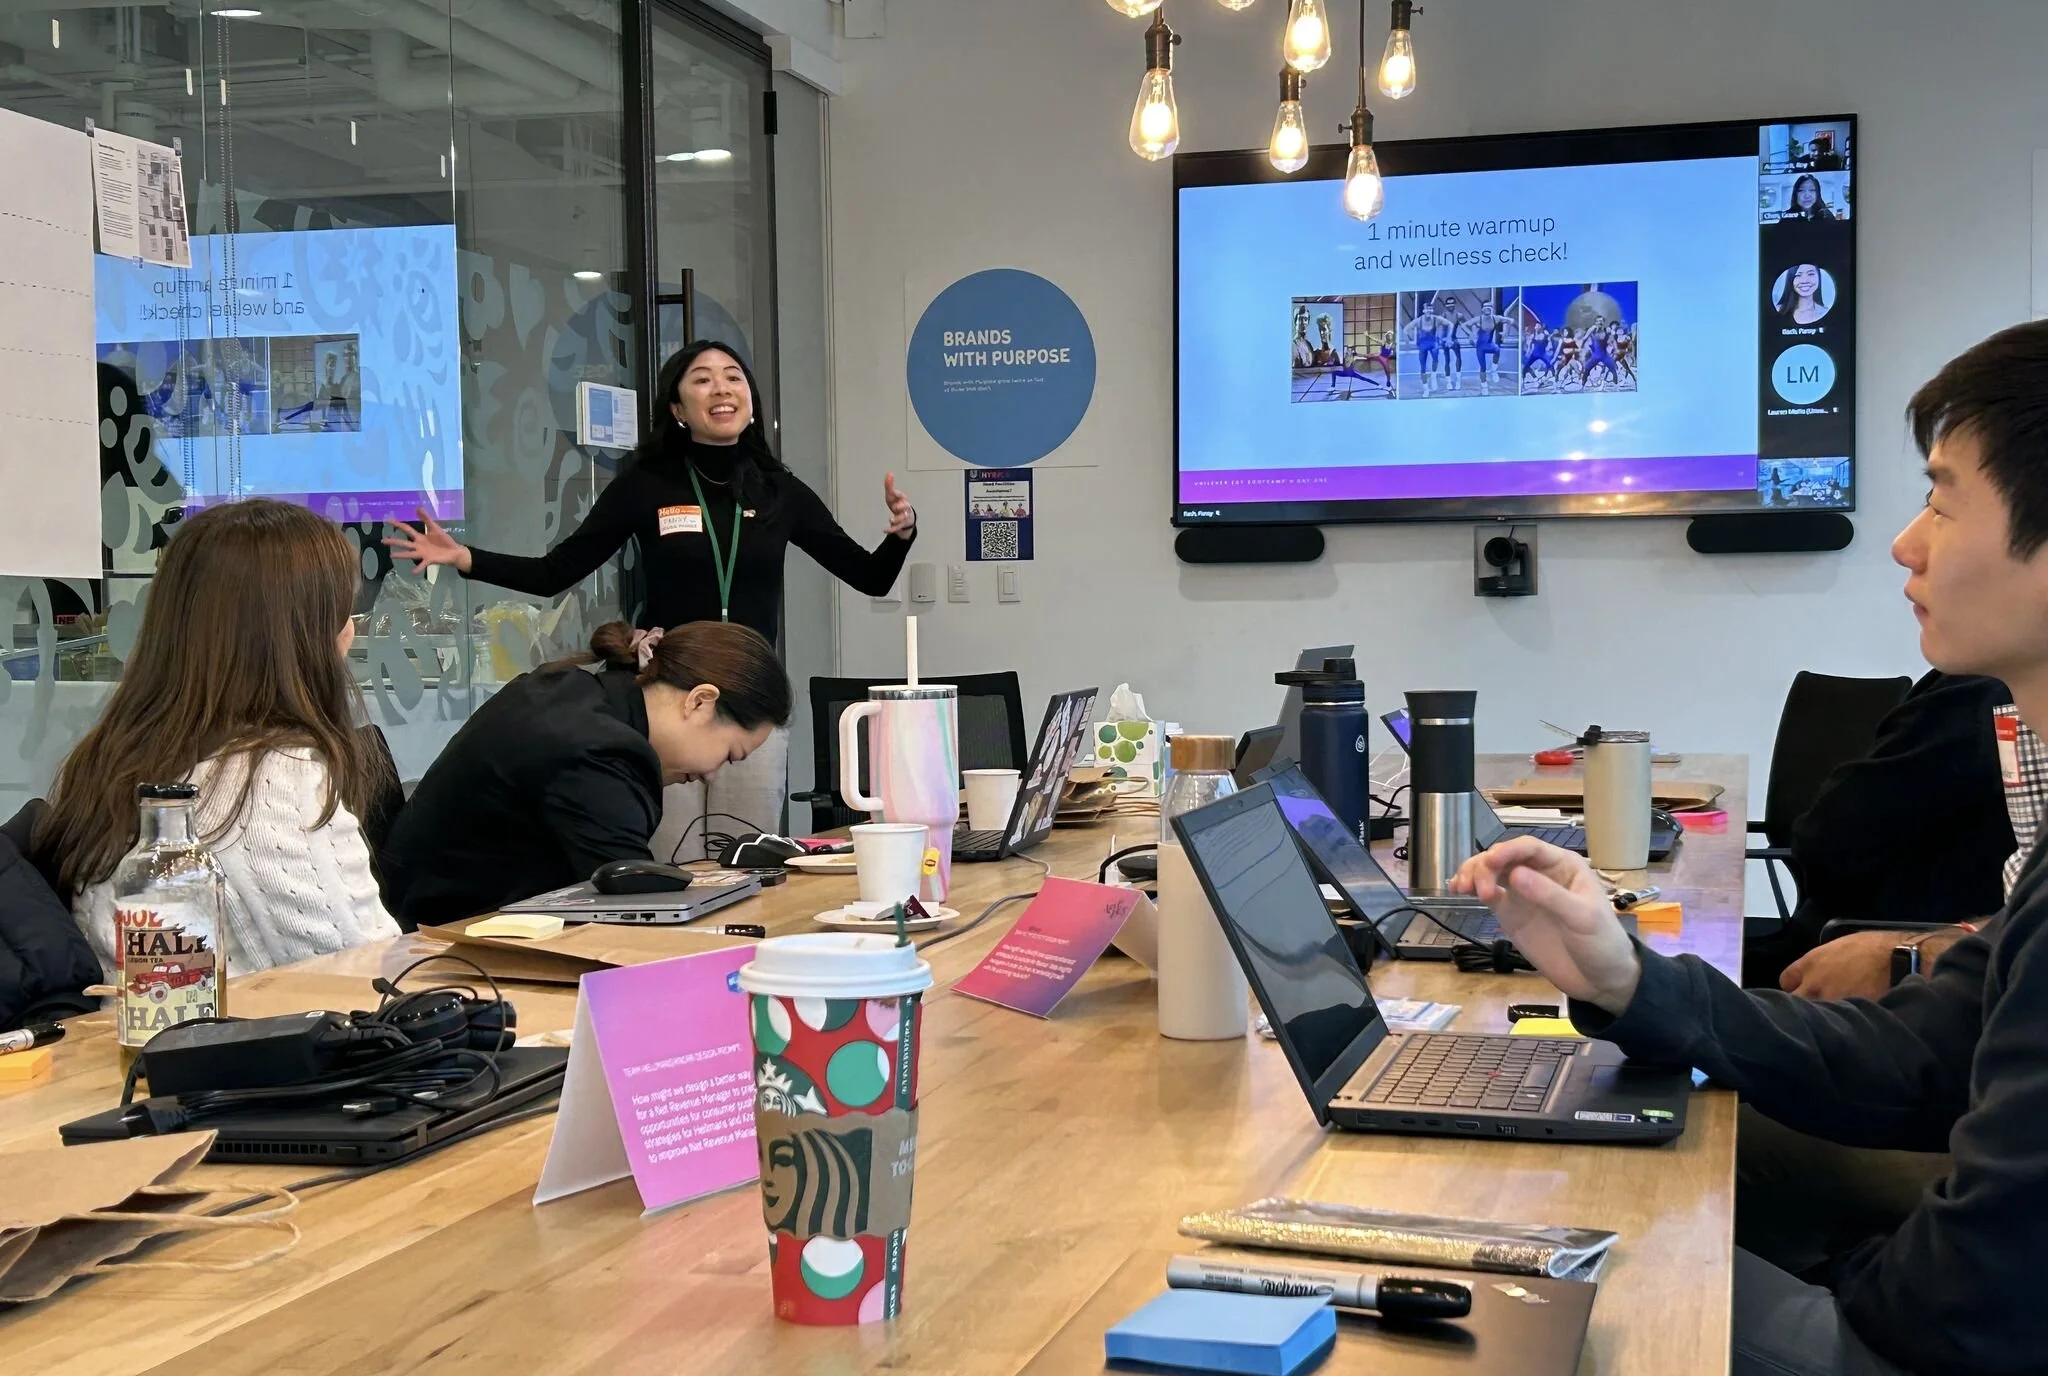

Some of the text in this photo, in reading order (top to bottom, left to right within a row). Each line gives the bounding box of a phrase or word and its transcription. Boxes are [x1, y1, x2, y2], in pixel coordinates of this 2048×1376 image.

[1367, 217, 1555, 241] 1 minute warmup
[1354, 242, 1568, 270] and wellness check!
[943, 329, 1012, 347] BRANDS
[943, 348, 1071, 367] WITH PURPOSE
[1787, 365, 1819, 383] LM
